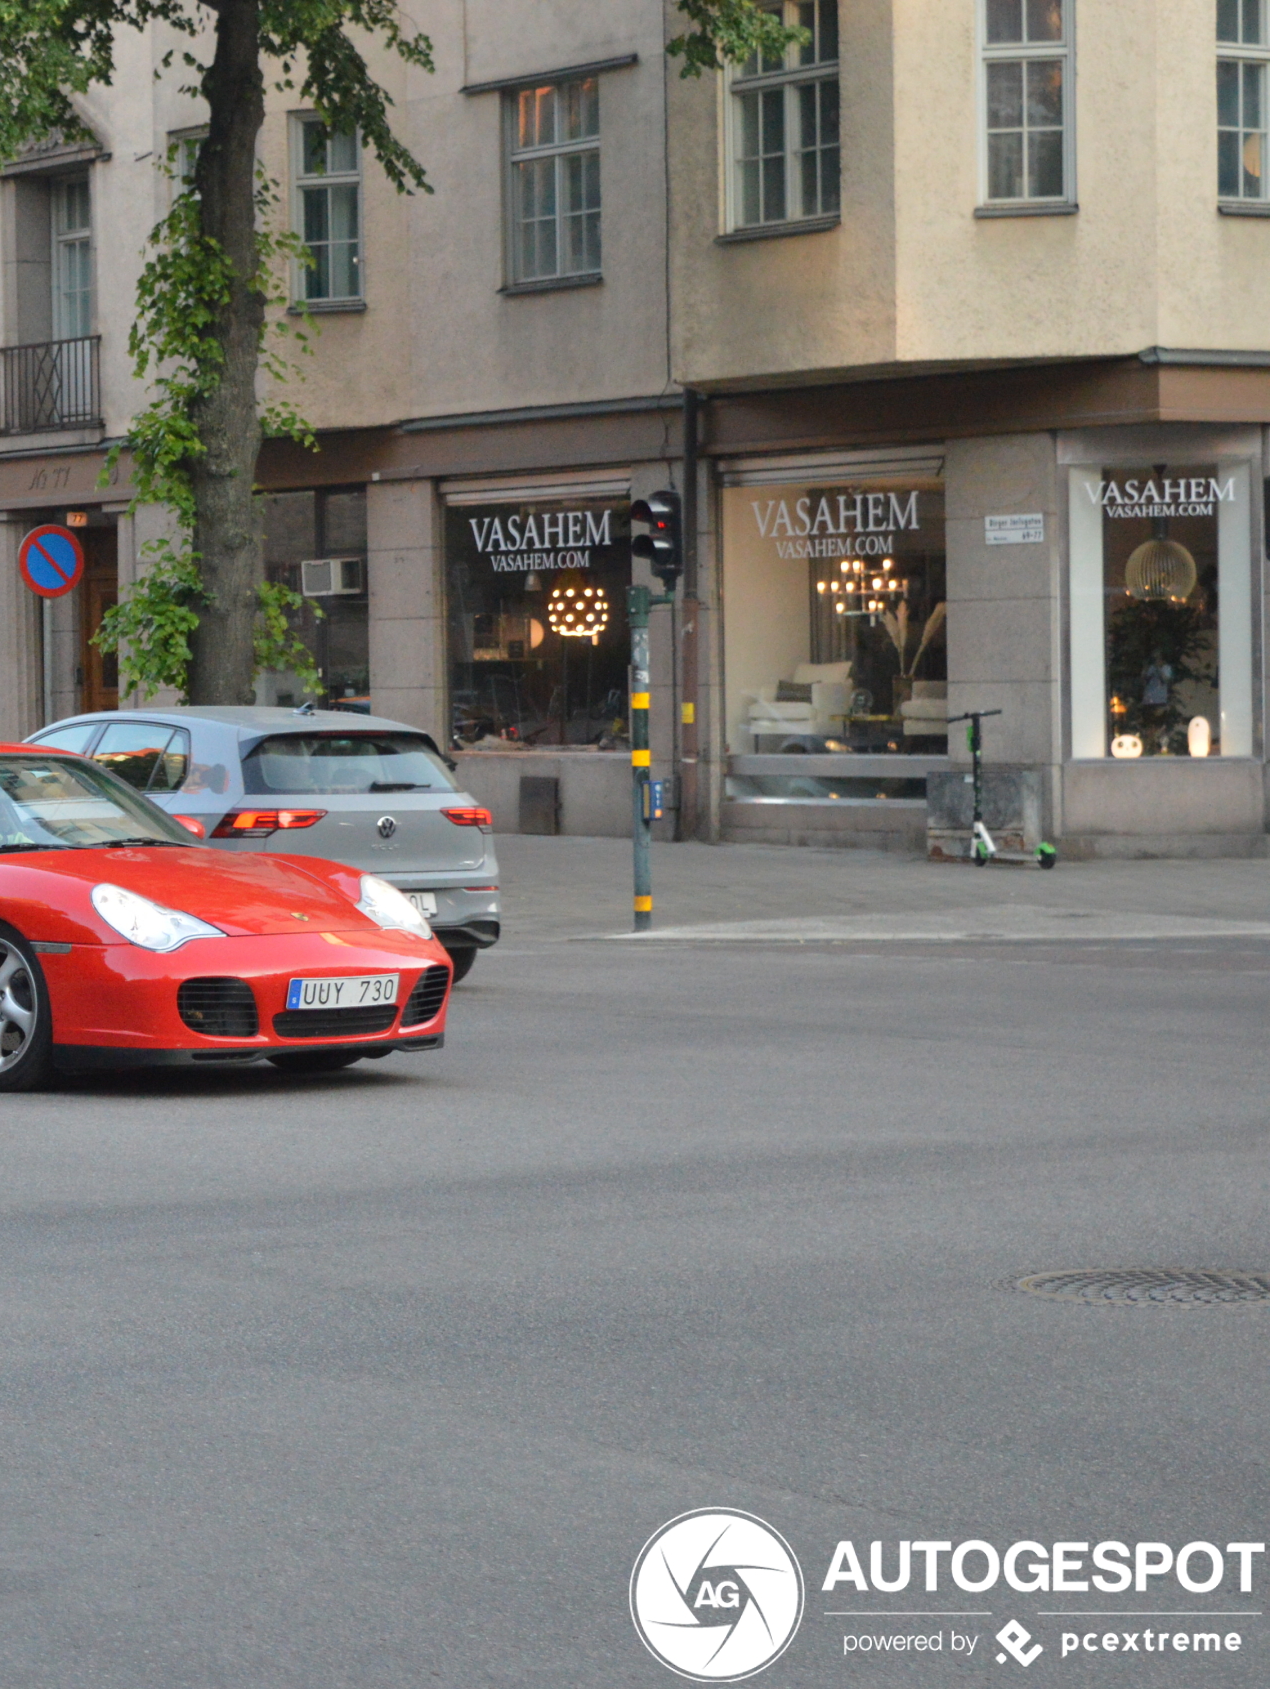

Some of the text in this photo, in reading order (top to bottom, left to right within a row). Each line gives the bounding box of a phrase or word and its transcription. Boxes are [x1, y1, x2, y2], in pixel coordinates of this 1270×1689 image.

[1084, 478, 1236, 505] VASAHEM
[751, 491, 920, 538] VASAHEM
[1106, 503, 1213, 518] VASAHEM.COM
[469, 510, 611, 552] VASAHEM
[776, 535, 893, 559] VASAHEM.COM
[491, 550, 590, 572] VASAHEM.COM
[303, 982, 344, 1005] UUY
[359, 979, 394, 1003] 730
